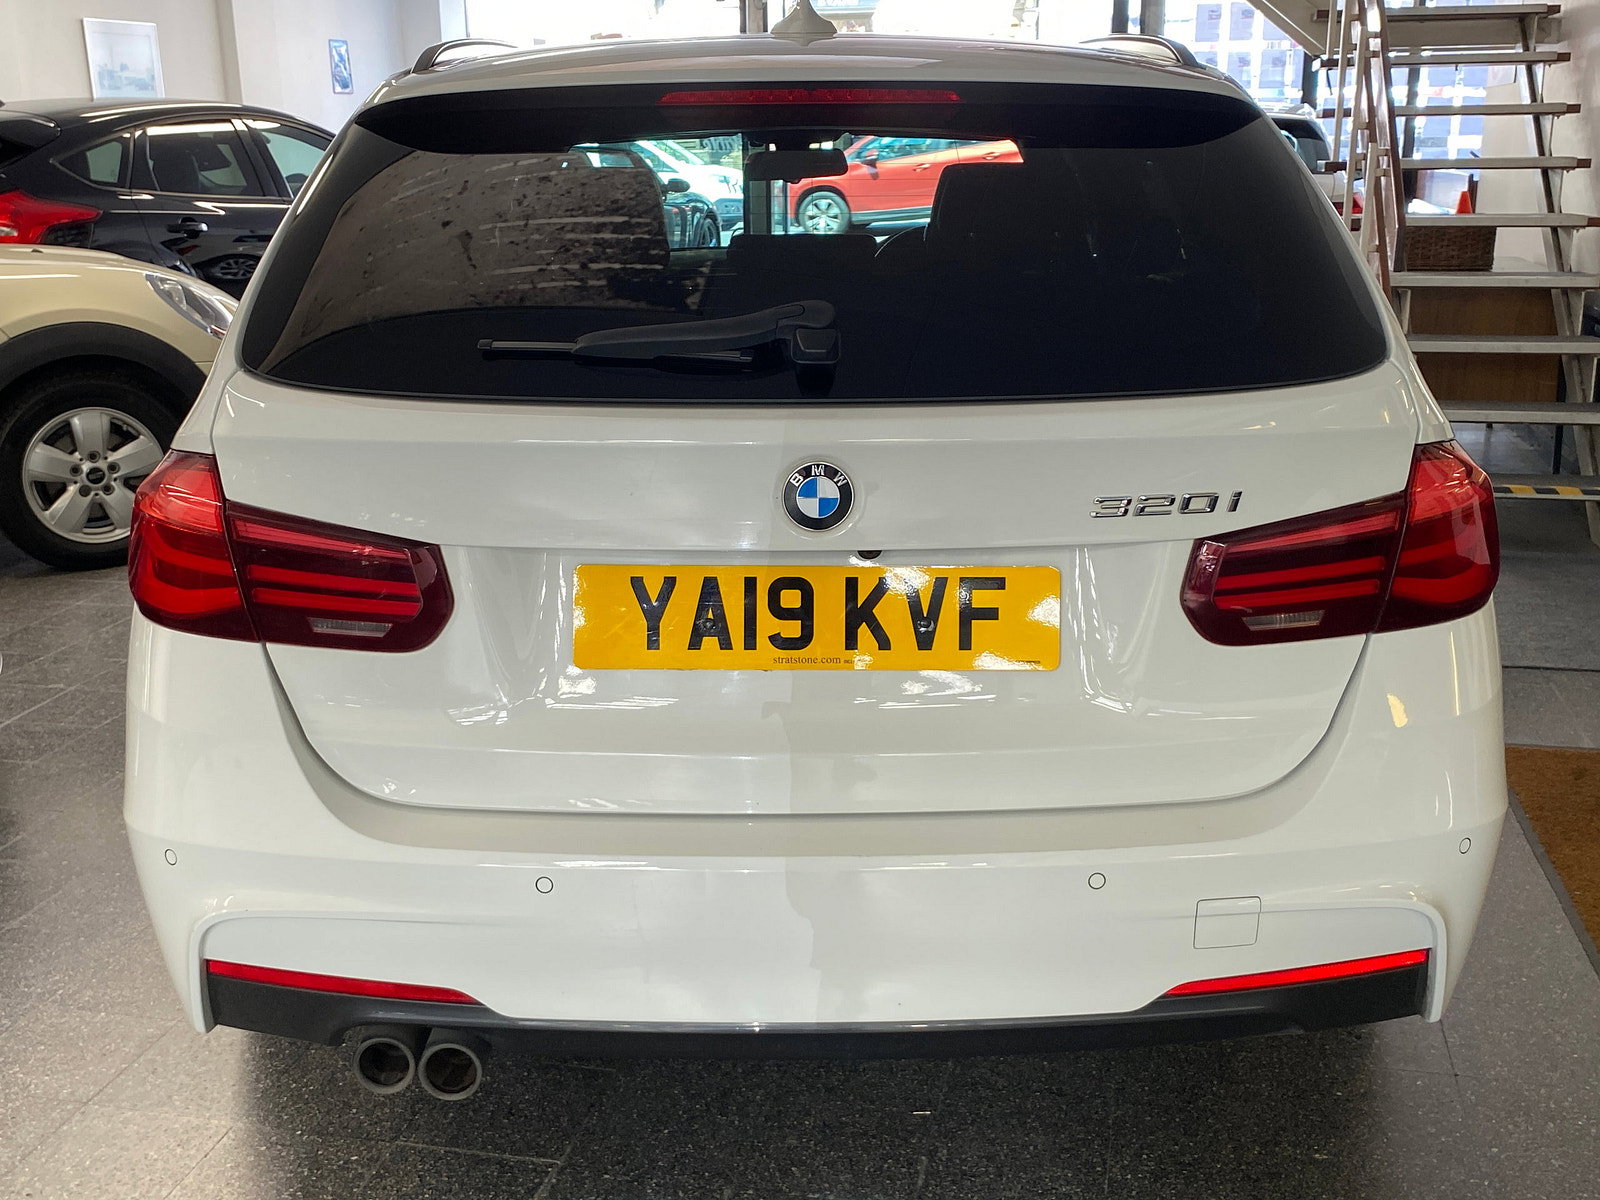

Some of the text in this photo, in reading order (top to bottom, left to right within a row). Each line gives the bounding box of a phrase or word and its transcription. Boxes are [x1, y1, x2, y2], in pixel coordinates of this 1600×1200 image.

[789, 464, 848, 487] BMW
[1089, 490, 1243, 518] 320i
[629, 576, 1007, 651] YA19 KVF
[772, 656, 842, 665] stratstone.com
